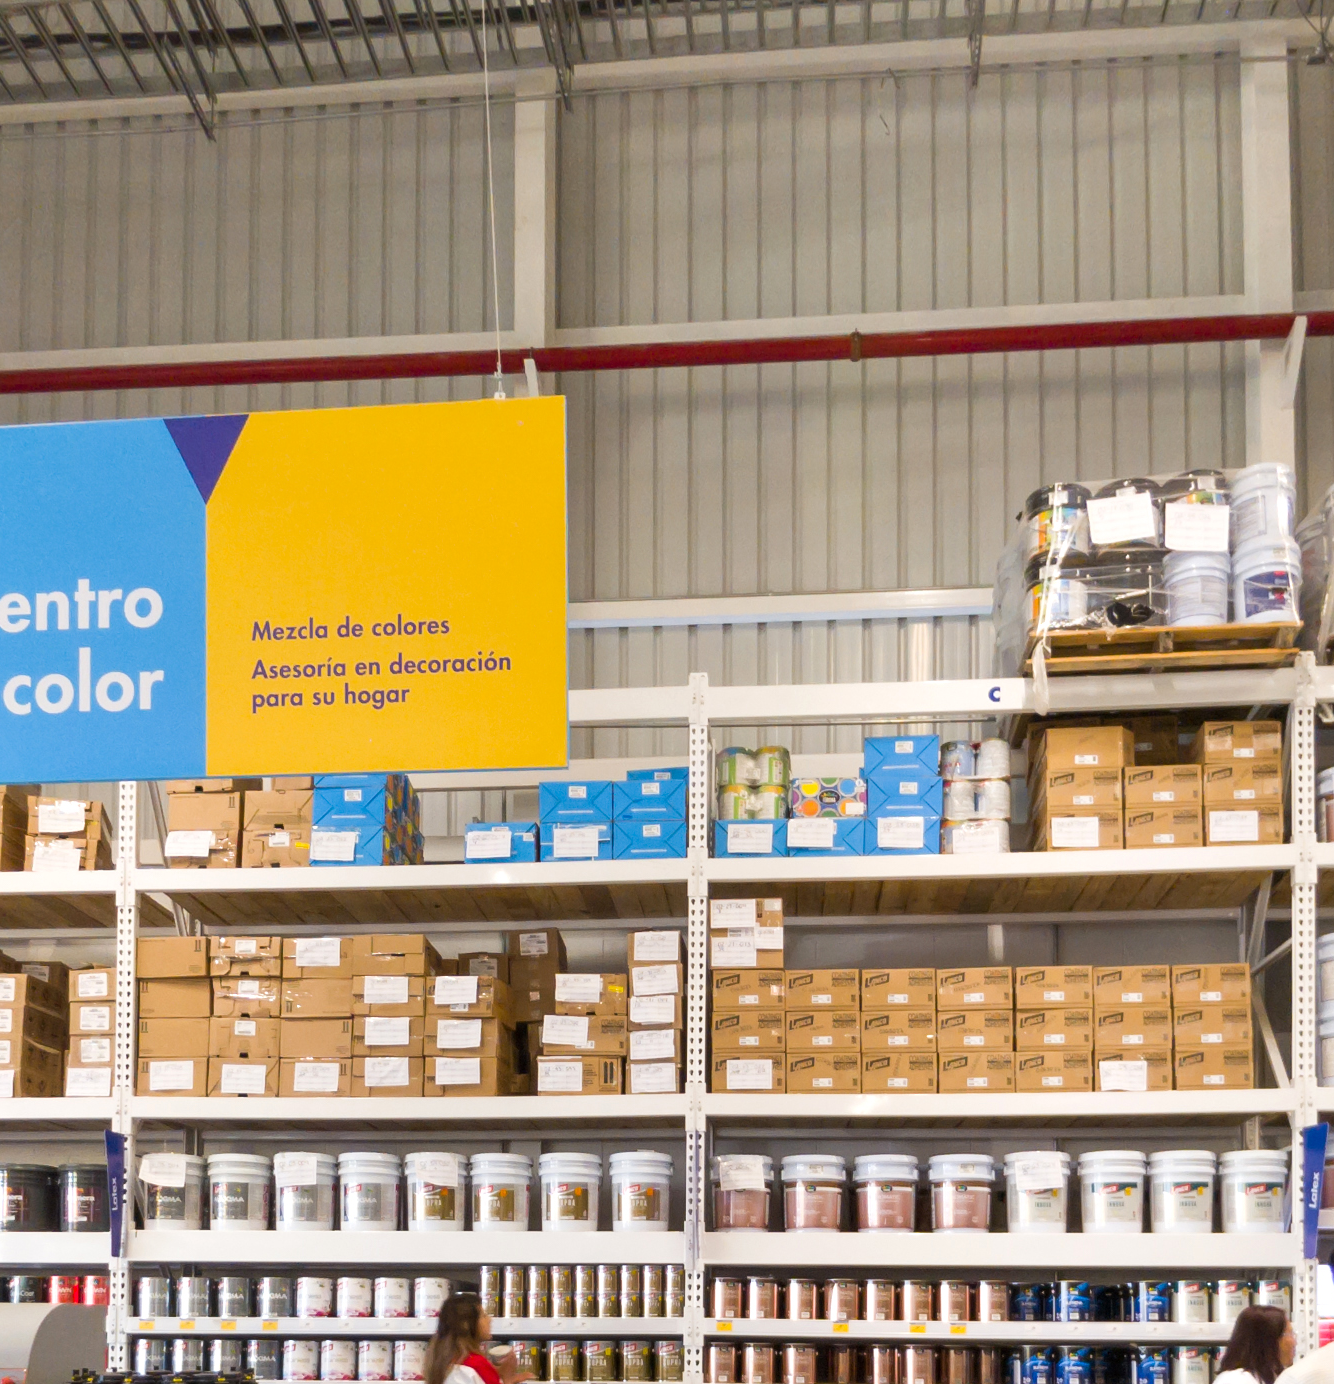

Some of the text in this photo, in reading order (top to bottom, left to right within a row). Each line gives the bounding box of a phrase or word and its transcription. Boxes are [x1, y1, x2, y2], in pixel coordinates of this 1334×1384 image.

[251, 613, 450, 642] Mezcla de colores
[251, 650, 511, 680] Asesoría en decoración
[2, 646, 165, 716] color
[988, 687, 1001, 702] C
[252, 682, 411, 714] para su hogar
[1308, 1172, 1320, 1209] Latex
